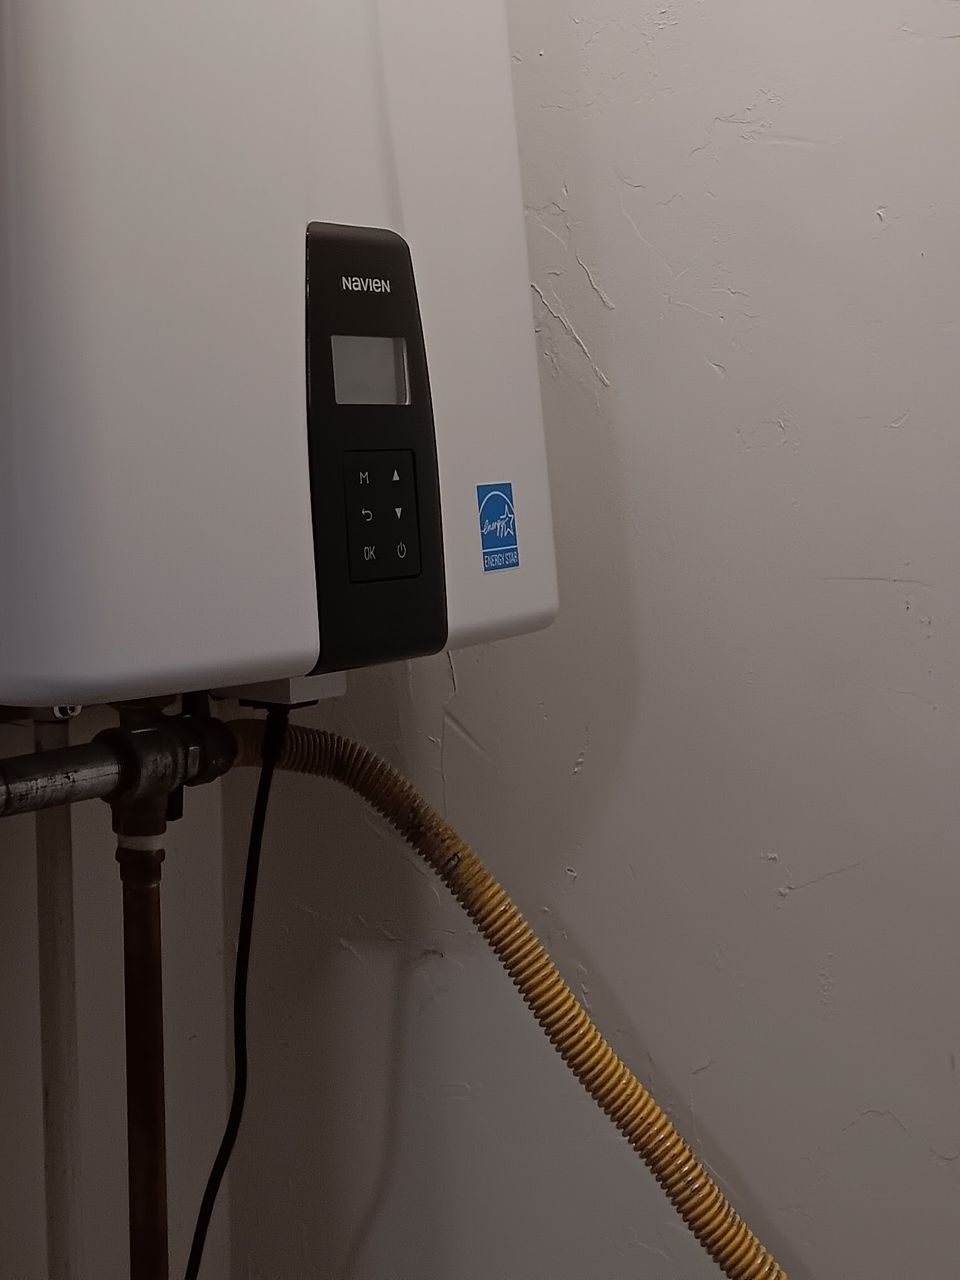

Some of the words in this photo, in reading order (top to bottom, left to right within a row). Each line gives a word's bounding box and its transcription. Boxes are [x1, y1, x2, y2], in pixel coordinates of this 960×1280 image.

[360, 472, 370, 484] M
[364, 546, 376, 560] OK
[484, 553, 504, 568] ENERGY
[505, 551, 518, 566] STAR
